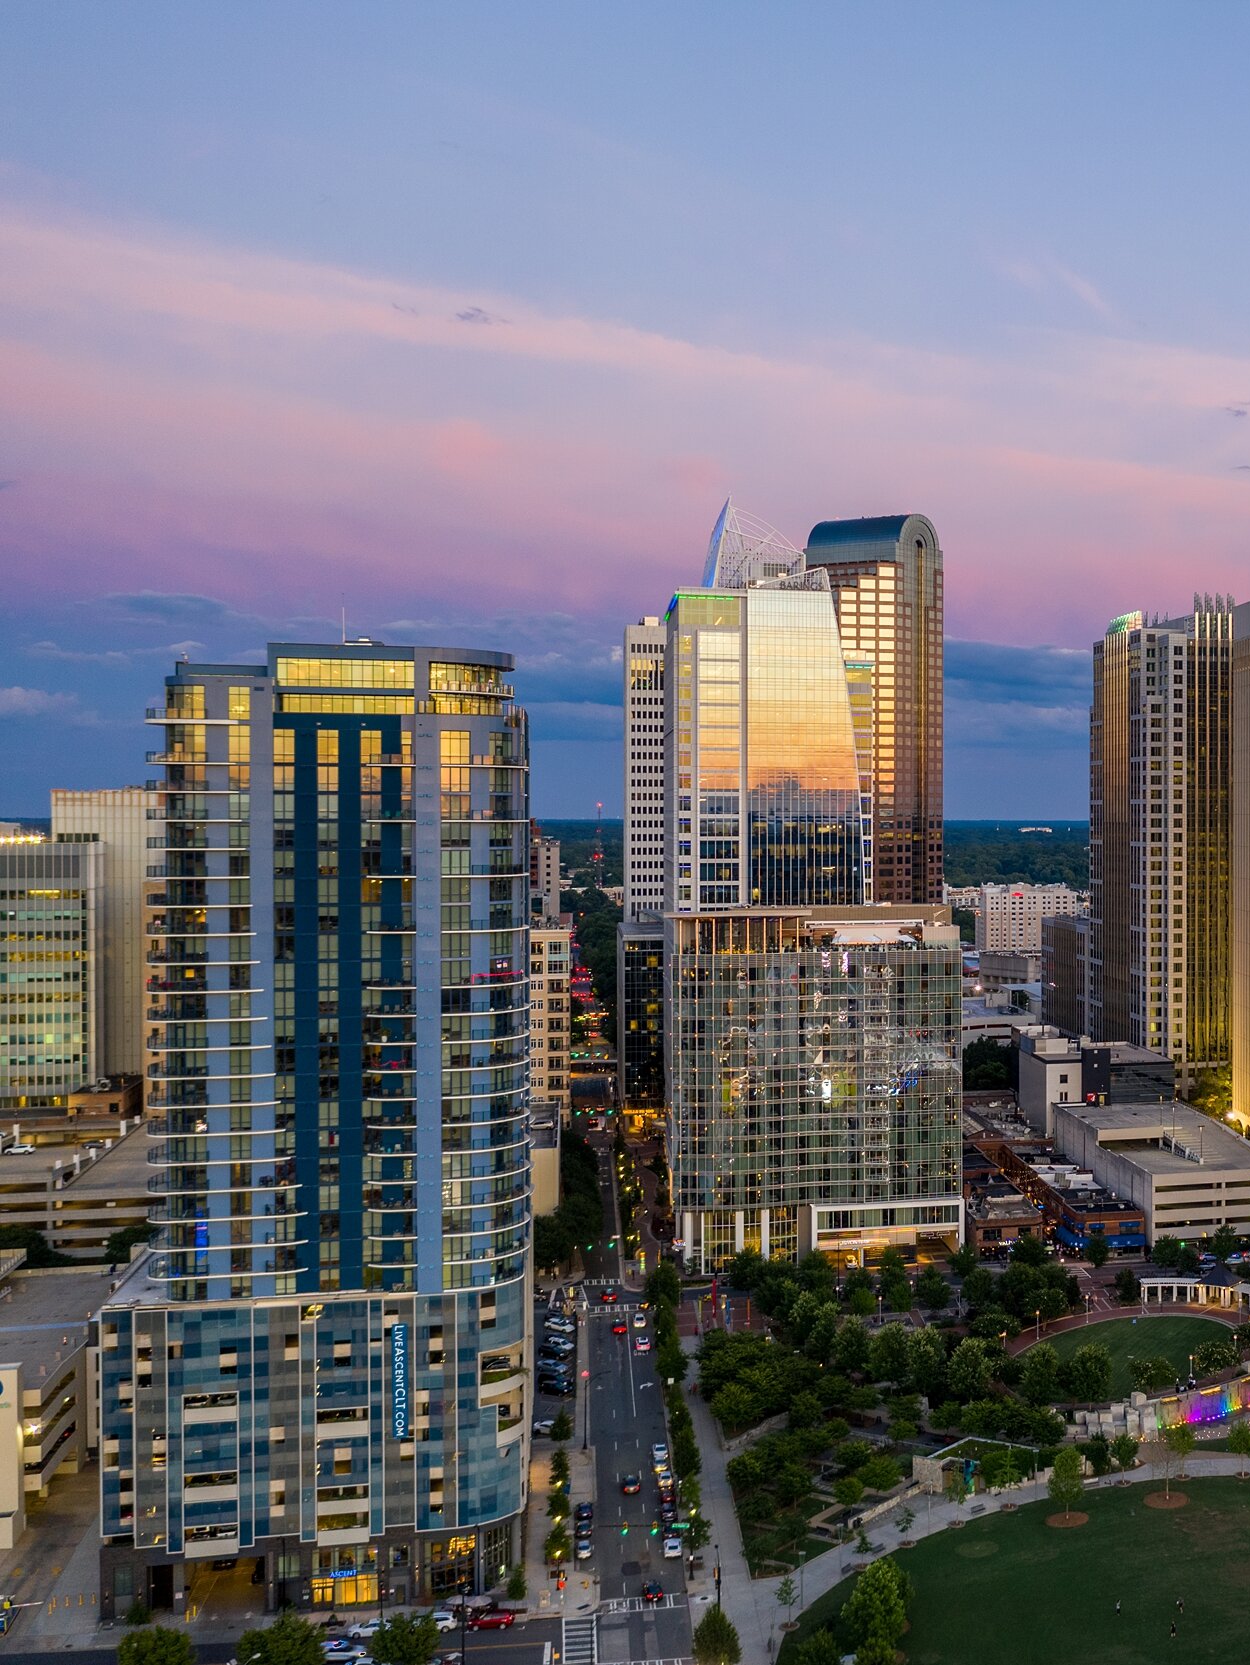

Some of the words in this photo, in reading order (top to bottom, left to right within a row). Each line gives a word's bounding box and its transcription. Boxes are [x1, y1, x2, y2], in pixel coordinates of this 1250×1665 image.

[780, 580, 824, 591] BARINGS
[394, 1325, 406, 1436] LIVEASCENTCLT.COM
[330, 1569, 357, 1578] ASCENT
